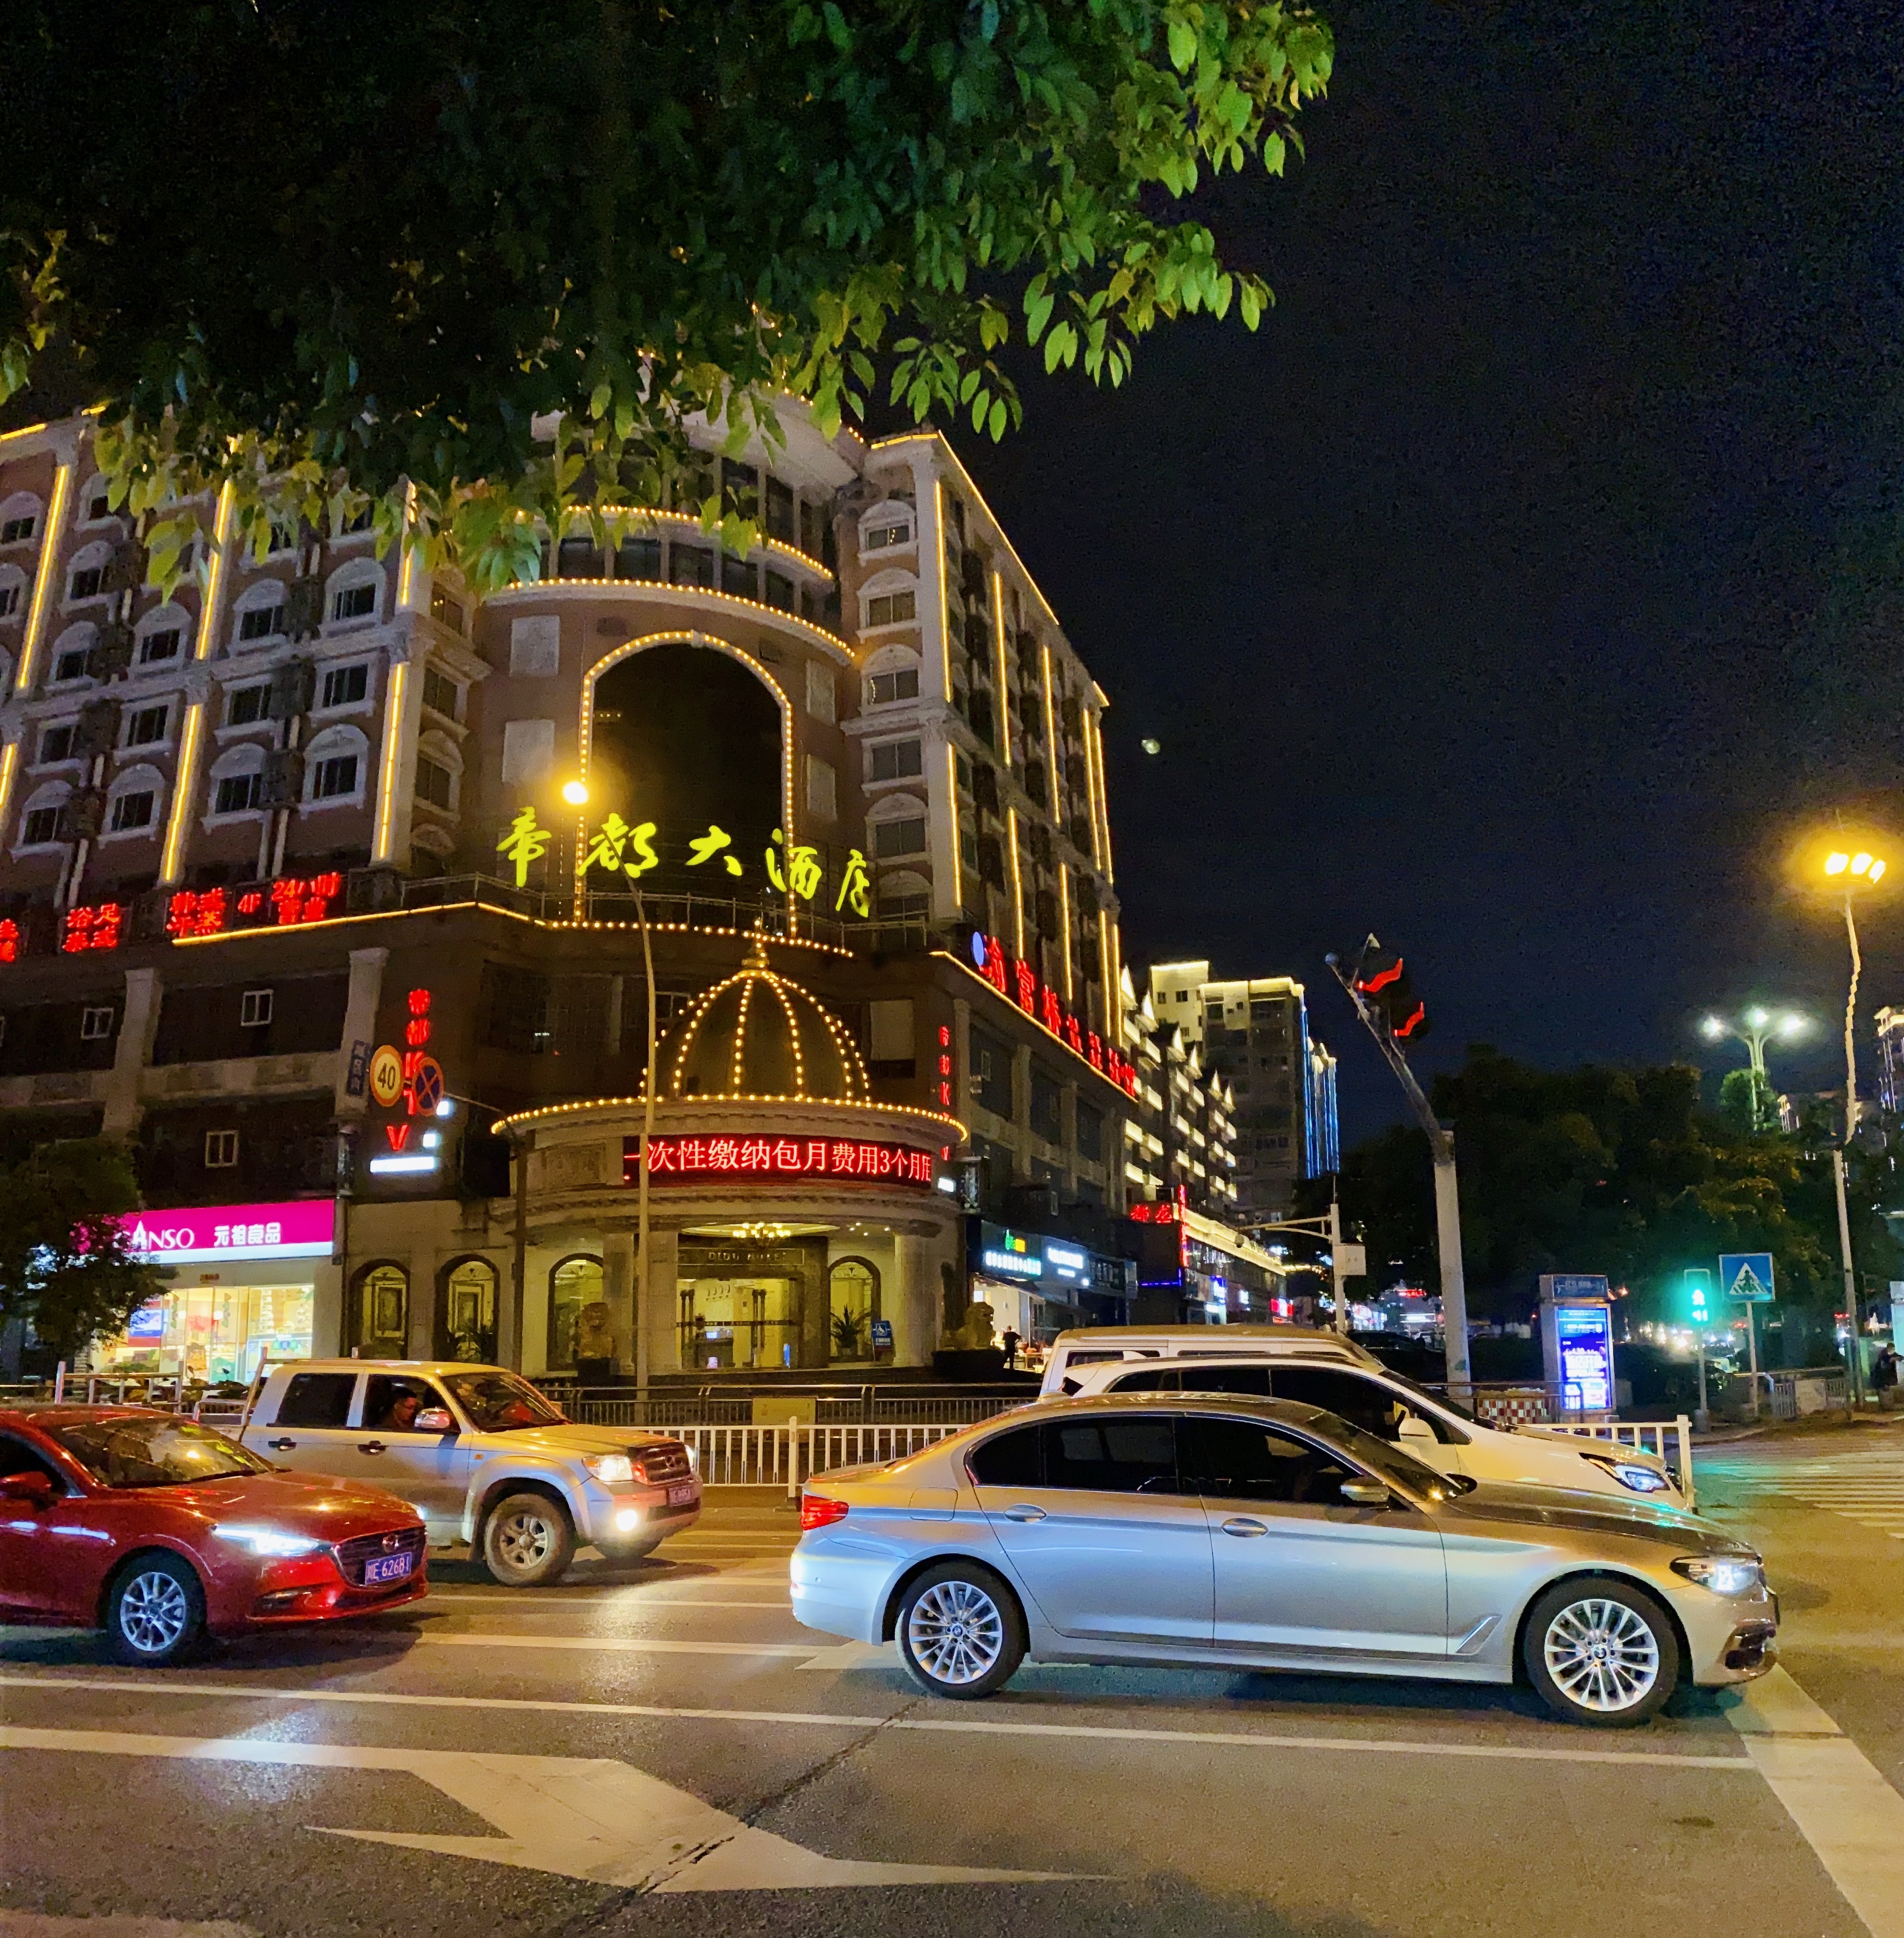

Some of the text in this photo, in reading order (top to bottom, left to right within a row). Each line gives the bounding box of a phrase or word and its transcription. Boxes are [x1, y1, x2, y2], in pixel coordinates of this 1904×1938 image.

[497, 806, 871, 918] 帝都大酒店
[238, 893, 261, 912] 4F
[377, 1062, 397, 1090] 40
[213, 1222, 281, 1247] 元祖食品
